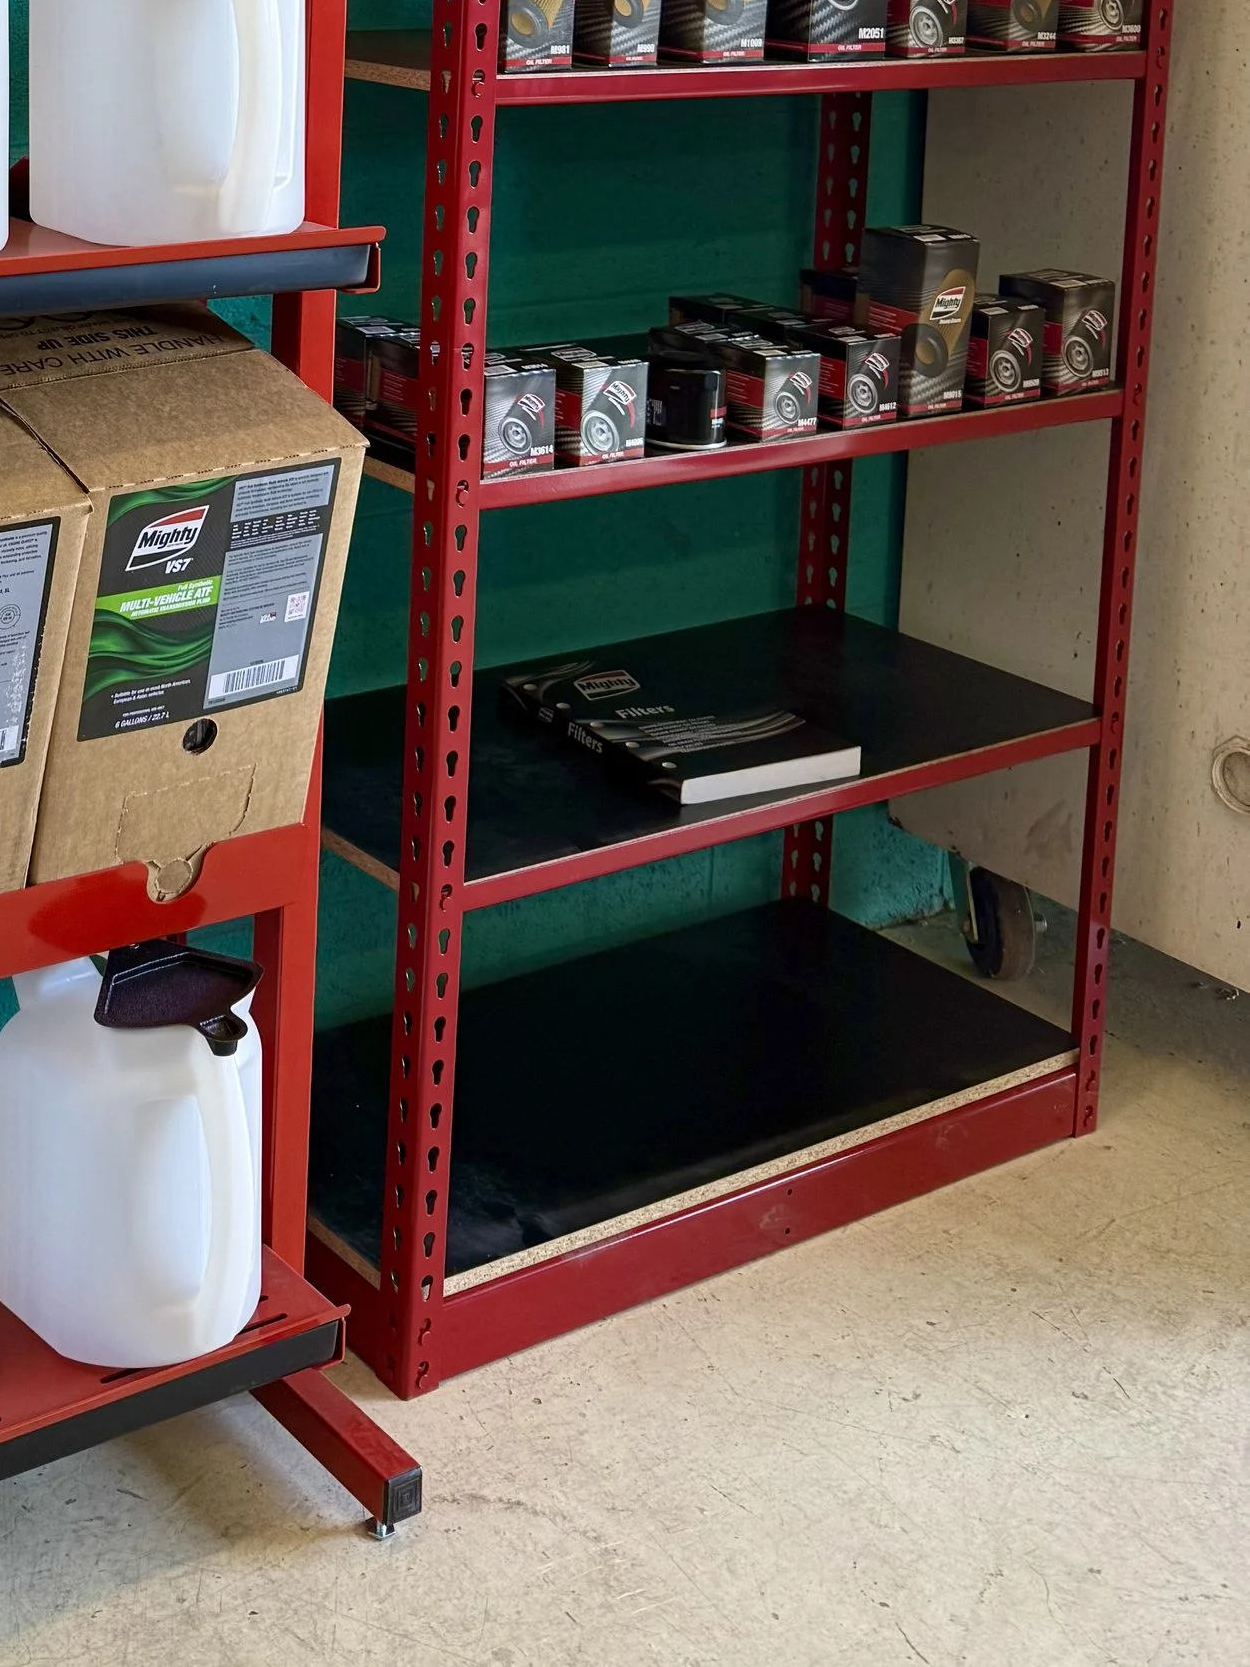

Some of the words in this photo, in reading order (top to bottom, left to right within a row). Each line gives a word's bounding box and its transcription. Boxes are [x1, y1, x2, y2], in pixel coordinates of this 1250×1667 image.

[858, 27, 884, 40] M2051
[935, 296, 960, 310] Mighty
[63, 332, 110, 347] SIDE
[113, 326, 158, 339] THIS
[37, 339, 63, 350] UP
[130, 335, 224, 354] HANDLE
[67, 347, 130, 365] WITH
[138, 525, 198, 549] Mighty
[165, 558, 191, 574] VS7
[120, 590, 192, 612] MULTI-VEHICLE
[194, 587, 213, 599] ATF
[615, 704, 674, 719] Filters
